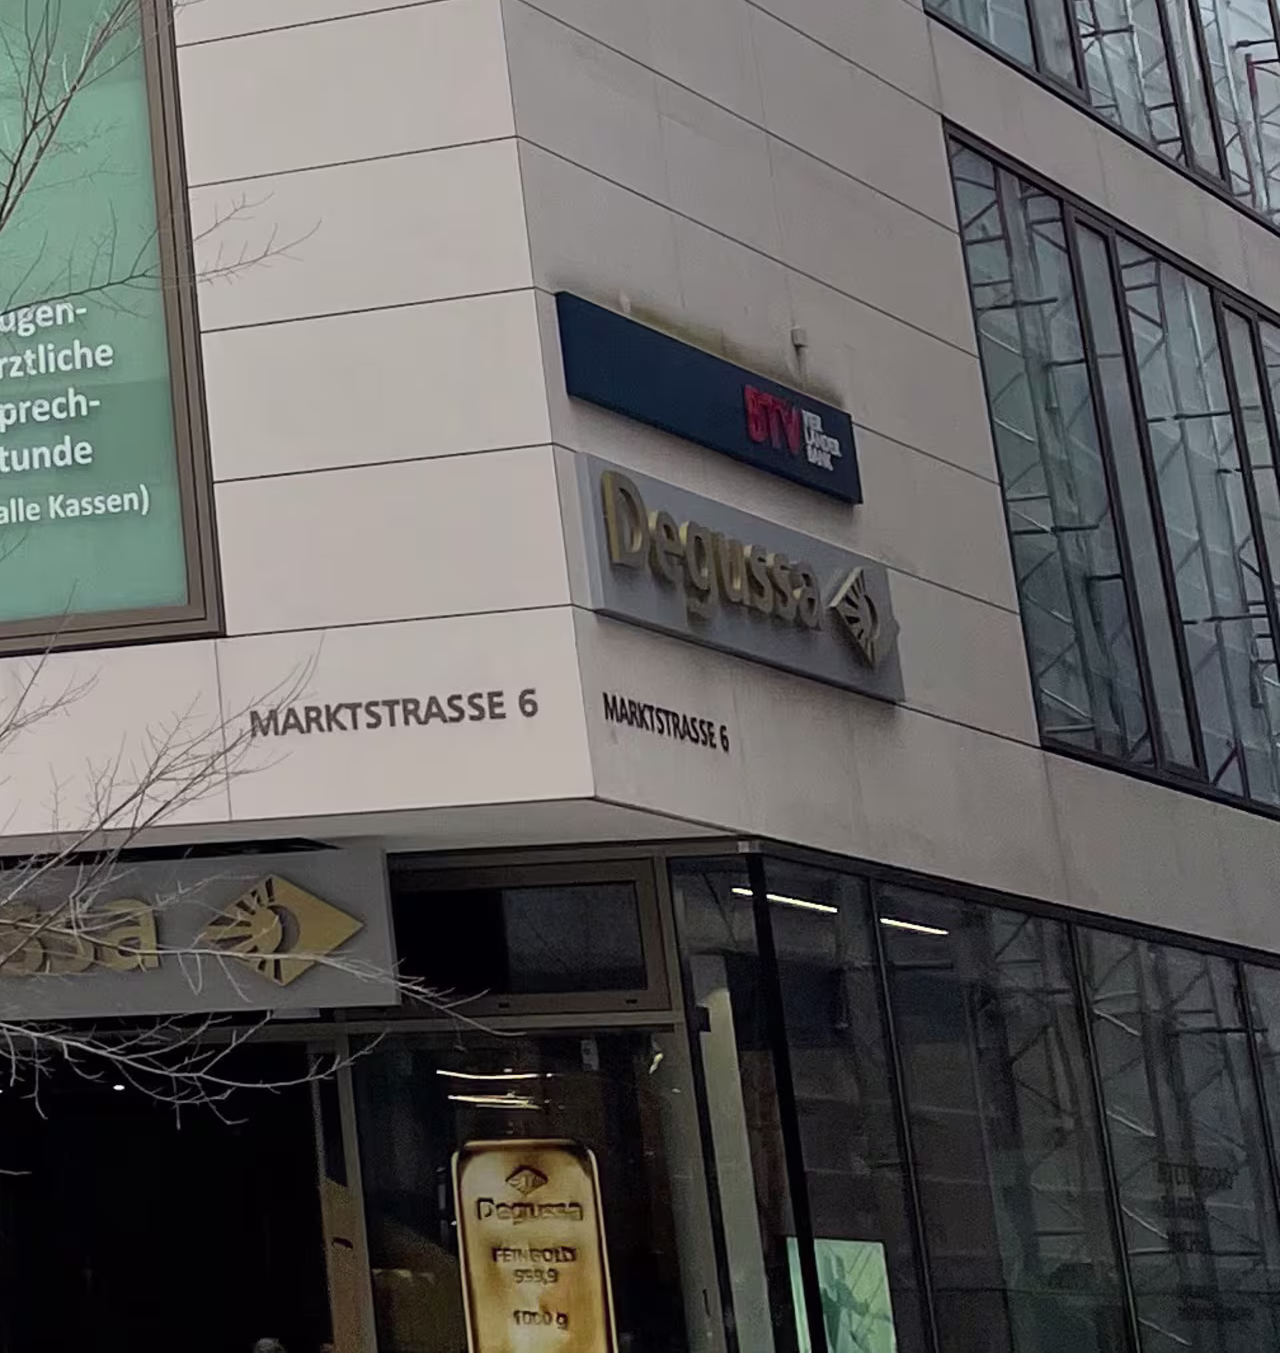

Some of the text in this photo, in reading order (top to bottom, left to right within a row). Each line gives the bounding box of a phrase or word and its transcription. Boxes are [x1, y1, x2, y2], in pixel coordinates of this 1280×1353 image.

[49, 484, 149, 519] Kassen)
[601, 470, 822, 631] Degussa
[249, 688, 538, 738] MARKTSTRASSE 6
[602, 692, 730, 753] MARKTSTRASSE 6
[477, 1197, 583, 1225] Degussa
